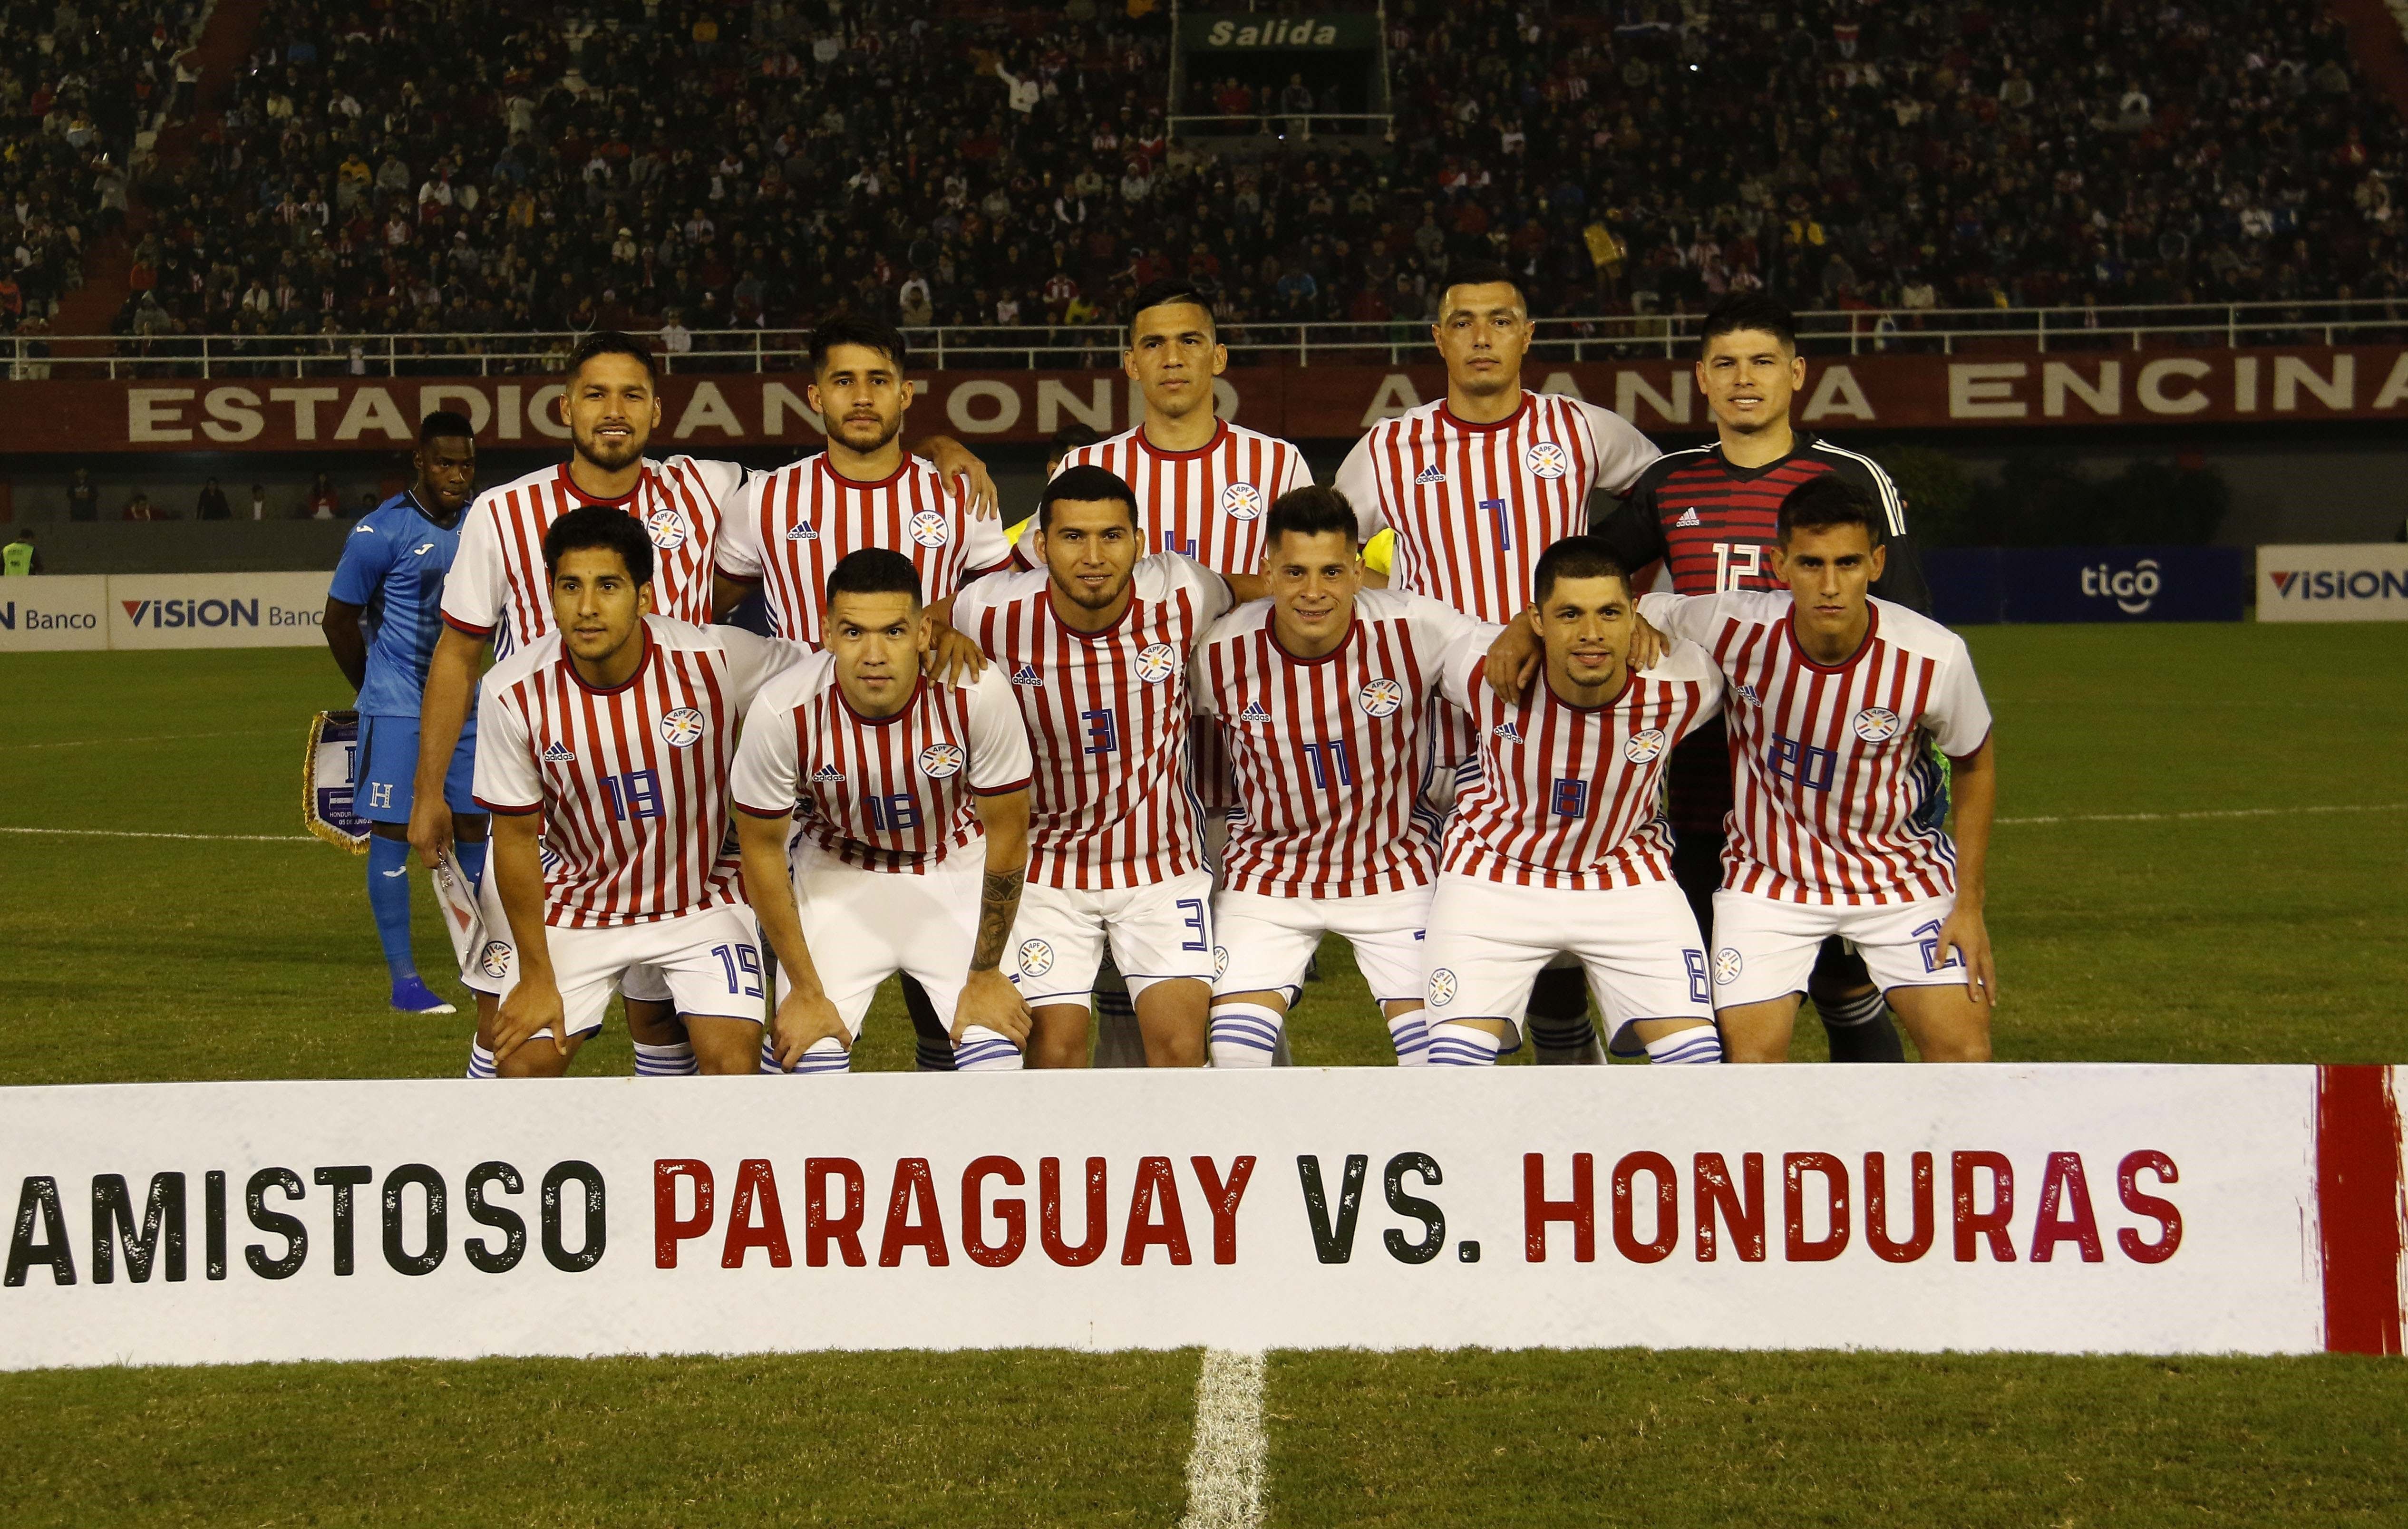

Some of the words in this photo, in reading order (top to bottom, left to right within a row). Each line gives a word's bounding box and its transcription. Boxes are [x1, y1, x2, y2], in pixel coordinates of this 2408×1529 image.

[1208, 19, 1337, 46] Salida
[673, 376, 1238, 439] ANONI
[1417, 475, 1444, 484] adidas
[656, 513, 669, 521] APF
[1479, 499, 1510, 550] 7
[1712, 543, 1760, 591] 12
[2081, 560, 2159, 613] tigo
[27, 610, 97, 629] Banco
[269, 607, 324, 626] Banc
[1147, 646, 1161, 654] APF
[1013, 677, 1041, 686] adidas
[1371, 681, 1386, 689] APF
[1082, 708, 1117, 754] 3
[1495, 728, 1522, 744] adidas
[544, 753, 573, 761] adidas
[1303, 740, 1351, 789] 11
[1767, 733, 1838, 791] 20
[369, 782, 393, 808] H
[600, 769, 664, 821] 19
[1552, 778, 1587, 818] 8
[1176, 899, 1207, 951] 3
[711, 944, 764, 999] 19
[1682, 949, 1709, 1005] 8
[4, 1160, 606, 1287] AMISTOSO
[654, 1155, 1257, 1269] PARAGUAY
[1297, 1152, 1480, 1264] VS.
[1523, 1149, 2183, 1264] HONDURAS
